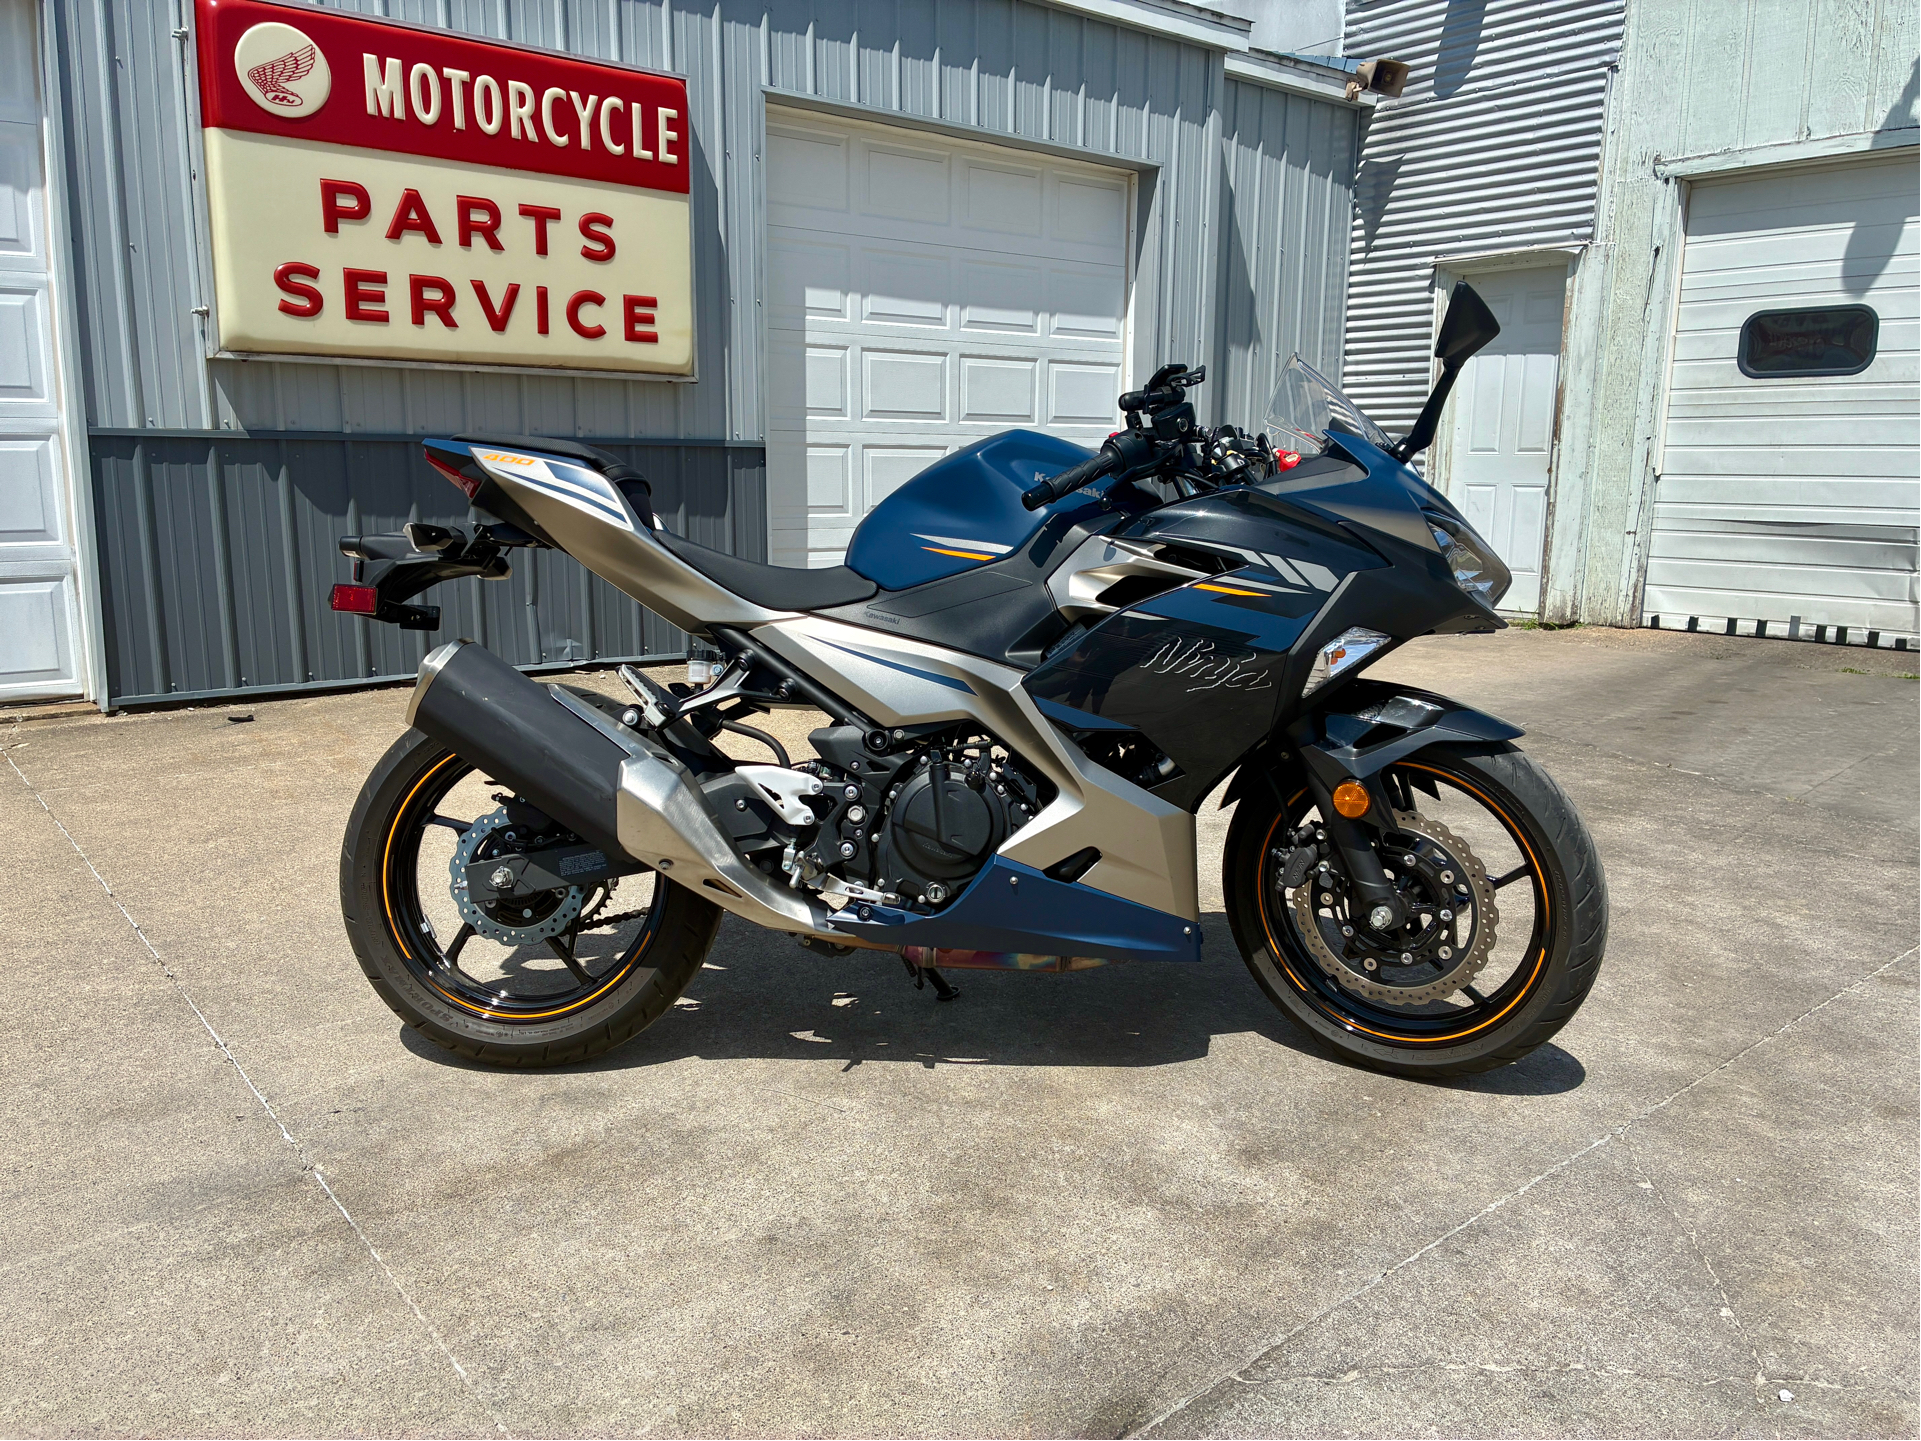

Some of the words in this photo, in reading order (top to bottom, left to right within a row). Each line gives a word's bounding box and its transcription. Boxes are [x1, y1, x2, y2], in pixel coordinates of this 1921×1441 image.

[363, 53, 679, 164] MOTORCYCLE
[320, 178, 616, 262] PARTS
[273, 262, 659, 343] SERVICE
[482, 453, 536, 466] 400
[1034, 471, 1105, 498] Ksaki
[864, 611, 900, 624] Kawasaki
[1140, 637, 1272, 692] Ninja
